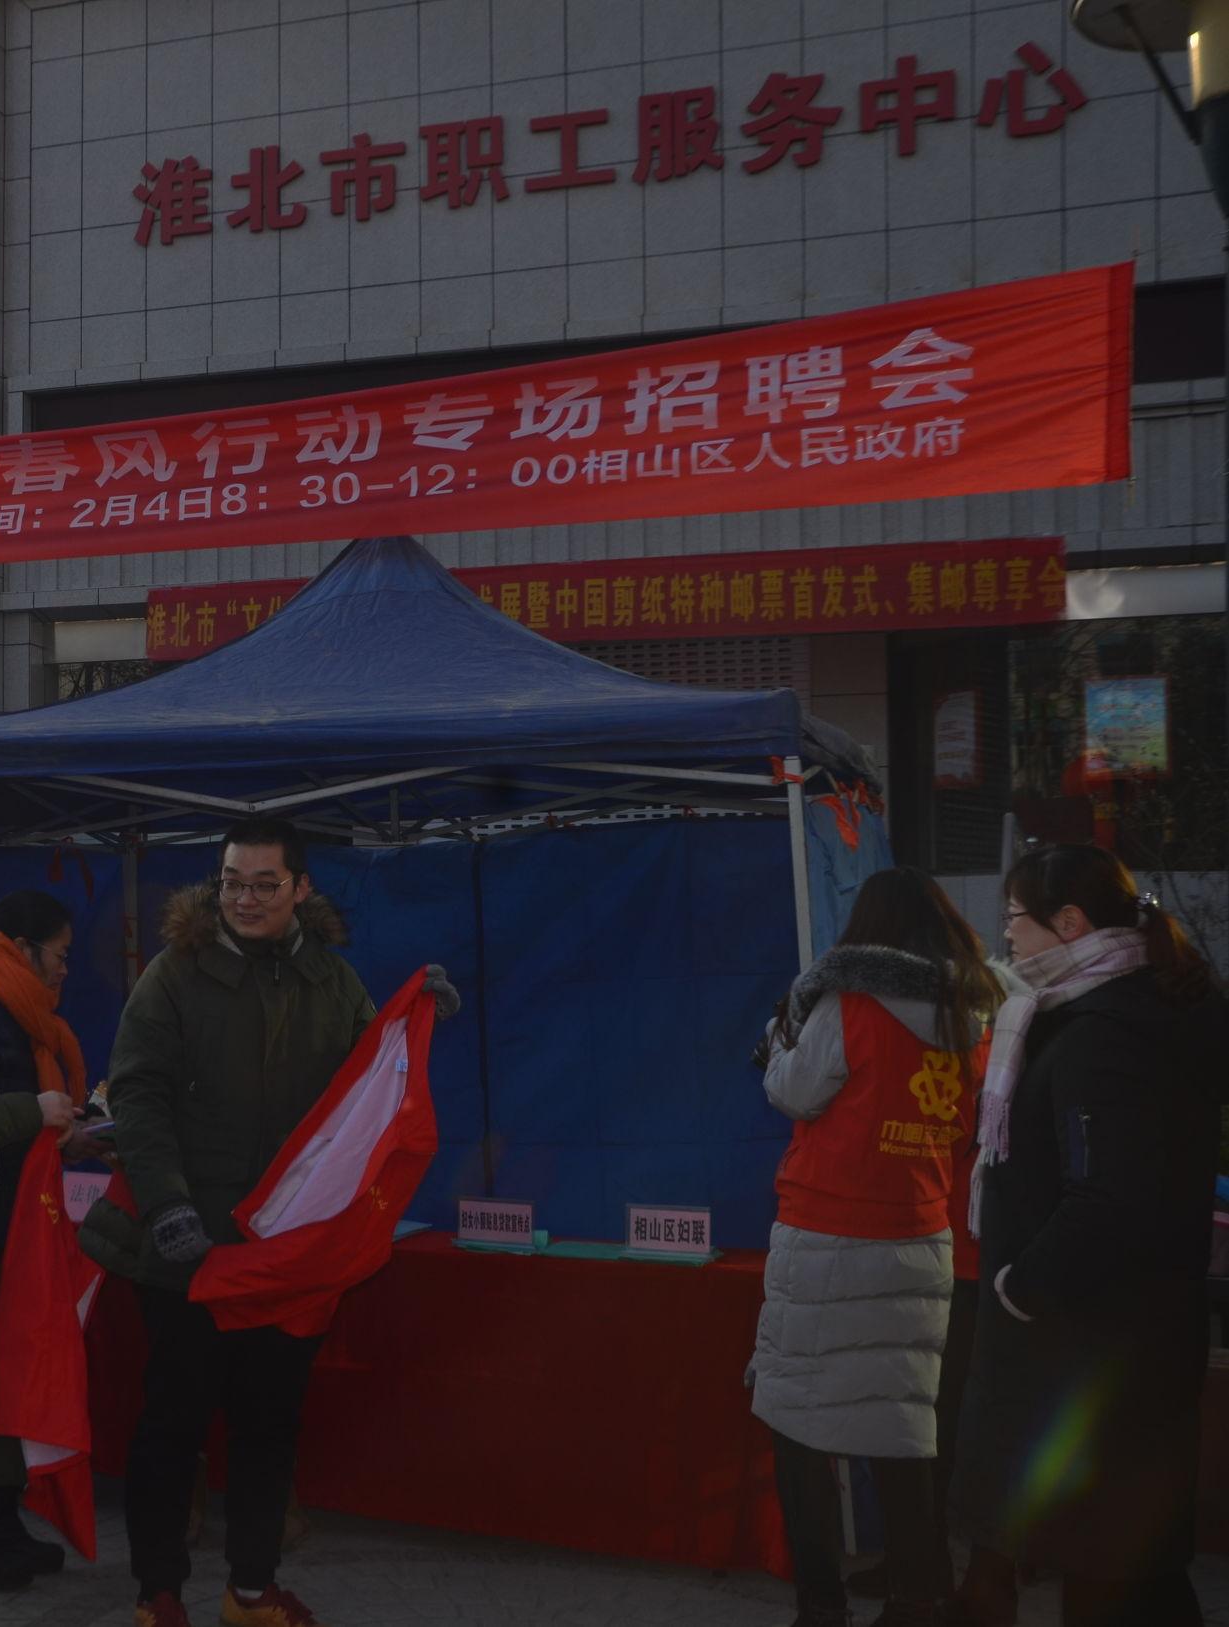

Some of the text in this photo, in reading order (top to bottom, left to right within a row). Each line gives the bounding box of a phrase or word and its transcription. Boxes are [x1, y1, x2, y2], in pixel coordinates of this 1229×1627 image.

[133, 41, 1087, 247] 淮北市职工服务中心
[634, 1215, 705, 1245] 相山区妇联
